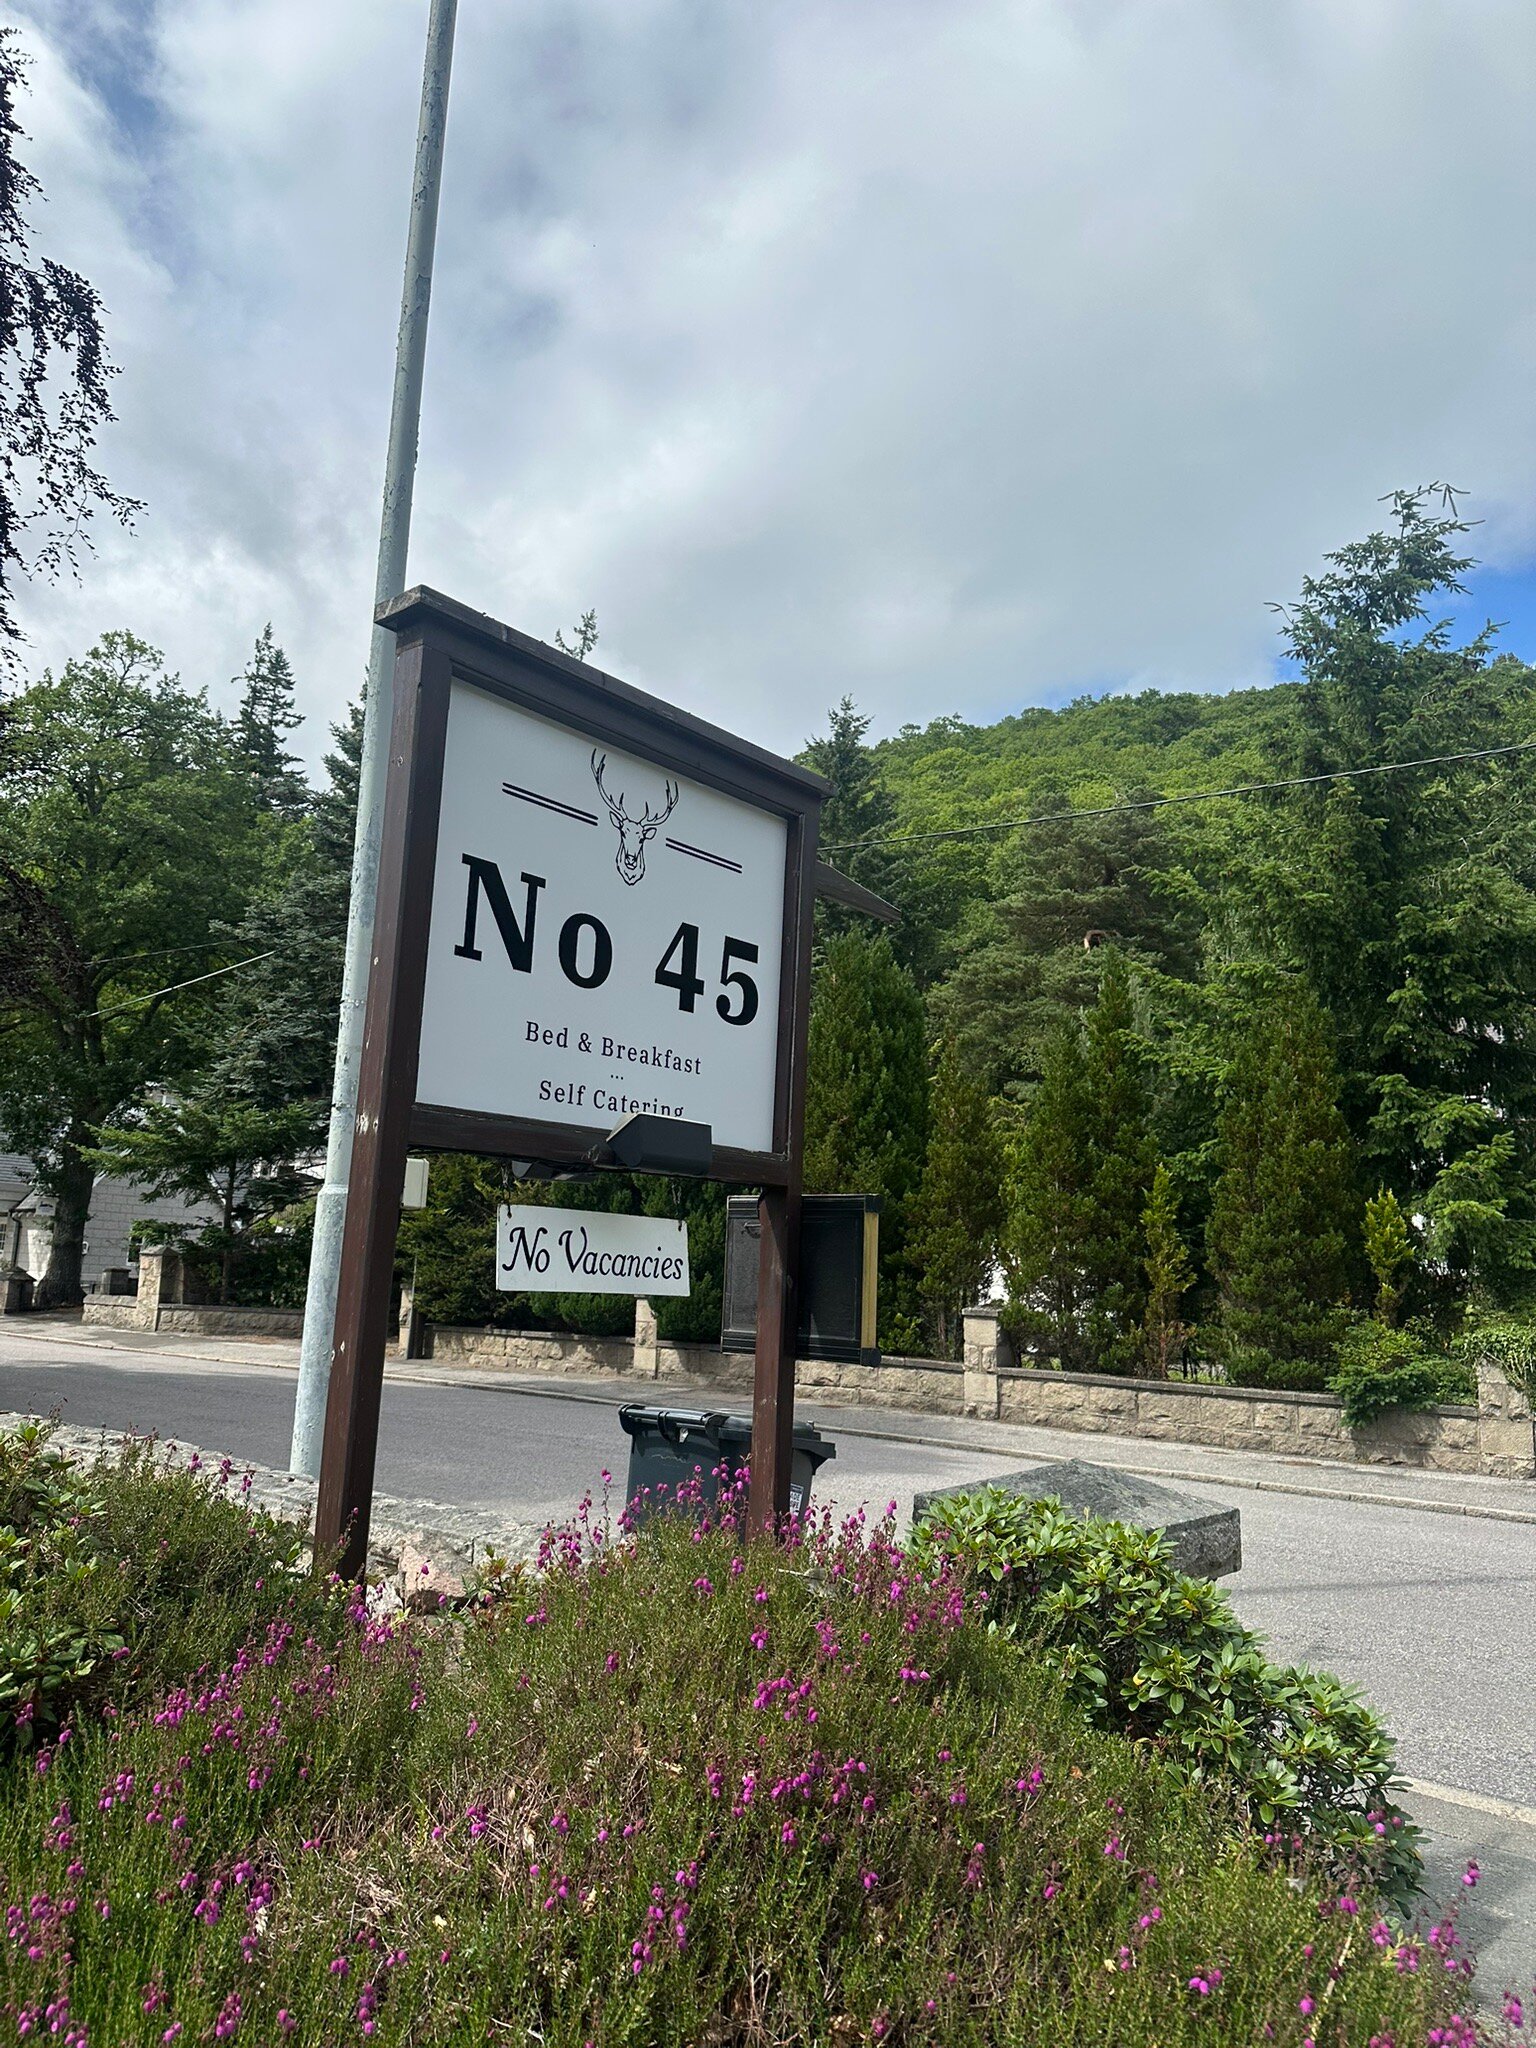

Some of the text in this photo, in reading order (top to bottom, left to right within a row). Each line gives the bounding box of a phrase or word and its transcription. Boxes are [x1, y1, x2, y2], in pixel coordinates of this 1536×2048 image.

[454, 853, 760, 1026] No 45
[526, 1020, 702, 1075] Bed & Breakfast
[539, 1079, 586, 1106] Self
[502, 1226, 684, 1280] No Vacancies
